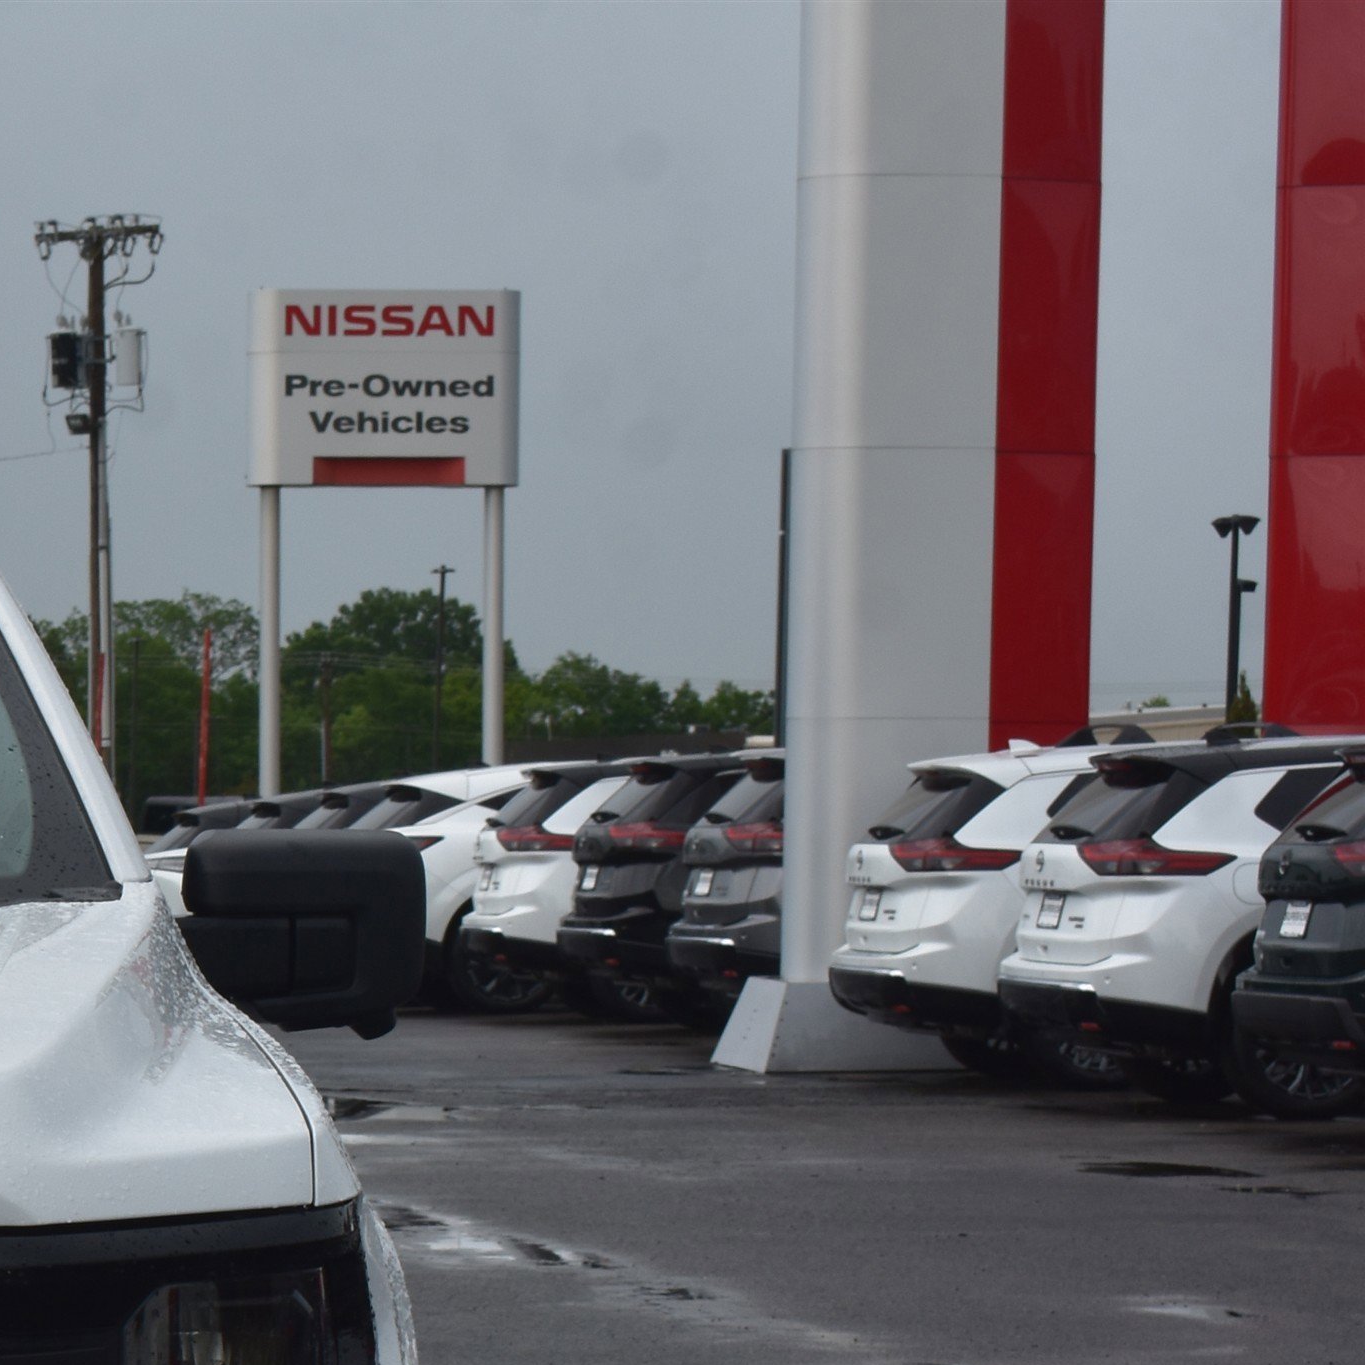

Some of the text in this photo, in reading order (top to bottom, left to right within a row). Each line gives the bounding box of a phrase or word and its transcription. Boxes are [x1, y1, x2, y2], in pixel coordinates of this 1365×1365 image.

[284, 304, 495, 337] NISSAN
[284, 374, 495, 398] Pre-Owned
[309, 411, 470, 434] Vehicles
